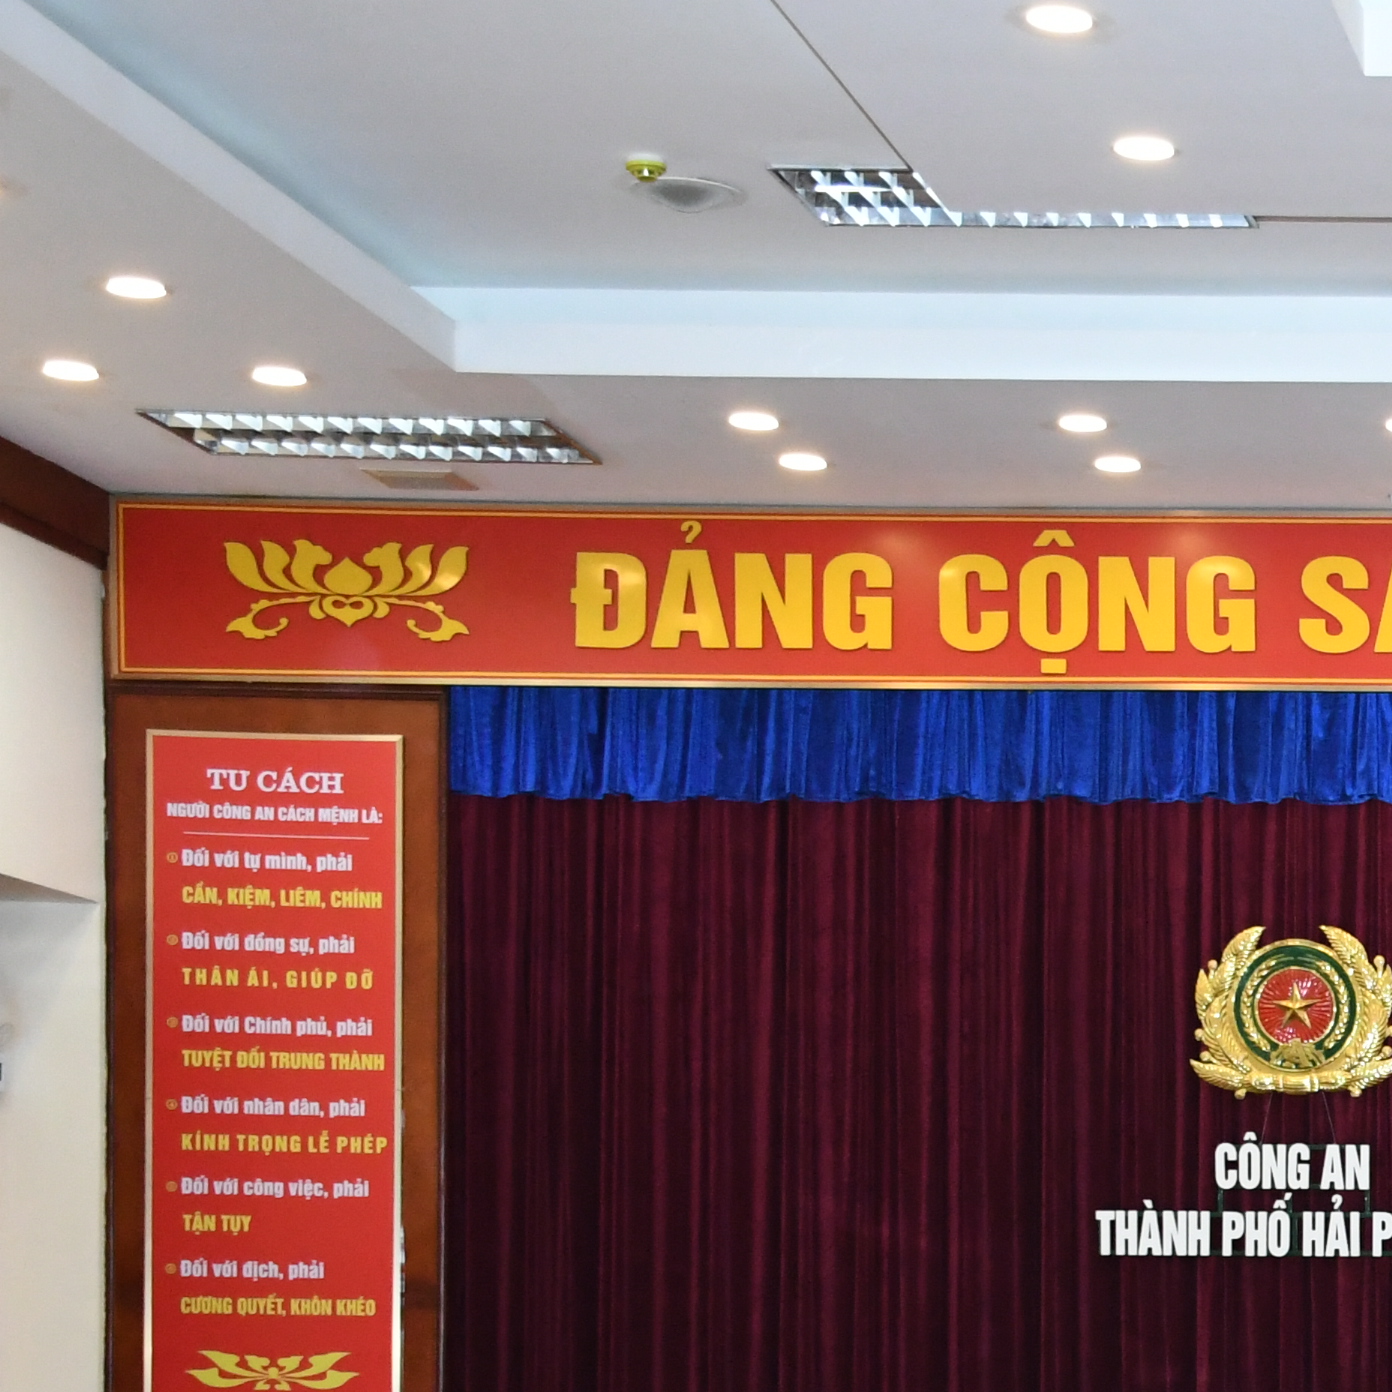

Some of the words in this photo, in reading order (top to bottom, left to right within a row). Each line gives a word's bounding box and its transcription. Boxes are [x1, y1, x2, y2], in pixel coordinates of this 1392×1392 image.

[571, 518, 896, 650] ĐẢNG
[935, 530, 1255, 677] CỘNG
[257, 767, 344, 793] CÁCH
[213, 802, 251, 819] CÔNG
[255, 806, 274, 820] AN
[278, 805, 315, 821] CÁCH
[318, 806, 358, 825] MỆNH
[362, 807, 382, 823] LÀ:
[182, 847, 209, 866] Đối
[214, 850, 239, 867] với
[316, 852, 352, 872] phải
[280, 887, 326, 909] LIÊM,
[331, 888, 382, 908] CHÍNH
[182, 930, 209, 949] Đối
[214, 933, 239, 950] với
[319, 934, 354, 954] phải
[182, 965, 238, 986] THÂN
[247, 967, 277, 989] ÁI,
[286, 968, 337, 988] GIÚP
[182, 1013, 209, 1032] Đối
[214, 1016, 239, 1033] với
[244, 1016, 291, 1034] Chính
[336, 1017, 372, 1037] phải
[182, 1047, 232, 1071] TUYỆT
[270, 1052, 325, 1069] TRUNG
[330, 1050, 384, 1070] THÀNH
[181, 1094, 208, 1113] Đối
[214, 1097, 239, 1114] với
[243, 1098, 284, 1115] nhân
[329, 1098, 365, 1118] phải
[182, 1130, 229, 1151] KÍNH
[237, 1134, 301, 1155] TRỌNG
[337, 1134, 387, 1153] PHÉP
[1215, 1132, 1310, 1192] CÔNG
[1320, 1144, 1370, 1190] AN
[181, 1175, 208, 1194] Đối
[214, 1178, 238, 1195] với
[243, 1178, 284, 1198] công
[333, 1178, 369, 1198] phải
[183, 1211, 216, 1235] TẬN
[221, 1215, 251, 1235] TỤY
[1095, 1199, 1210, 1256] THÀNH
[1222, 1191, 1292, 1257] PHỐ
[1302, 1194, 1360, 1257] HẢI
[180, 1258, 207, 1277] Đối
[212, 1260, 237, 1277] với
[288, 1260, 324, 1280] phải
[291, 1295, 332, 1315] KHÔN
[336, 1296, 376, 1316] KHÉO
